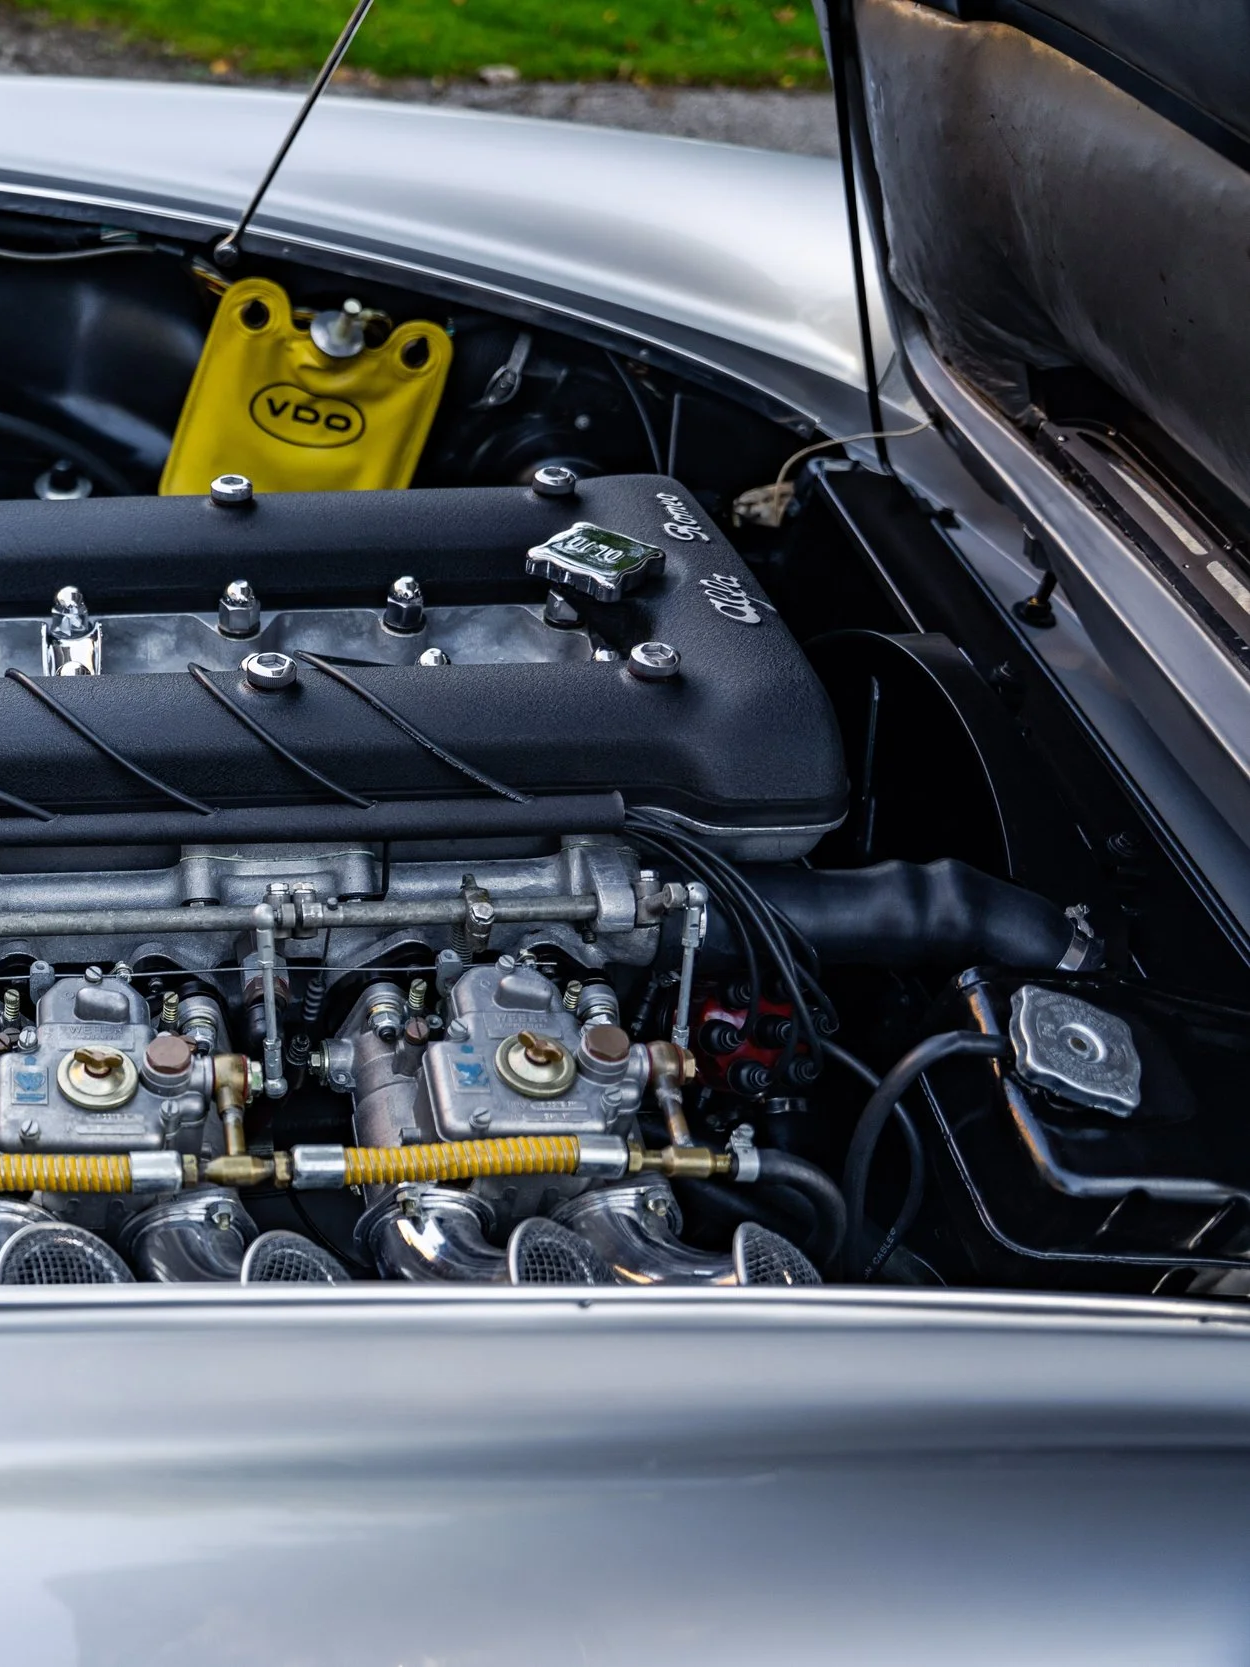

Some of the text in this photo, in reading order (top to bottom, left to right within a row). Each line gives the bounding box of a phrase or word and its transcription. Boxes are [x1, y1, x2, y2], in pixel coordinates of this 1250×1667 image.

[266, 397, 352, 432] VDO
[566, 535, 625, 563] OLIO
[656, 492, 761, 624] Alfa Romeo
[872, 1234, 895, 1265] CABLE
